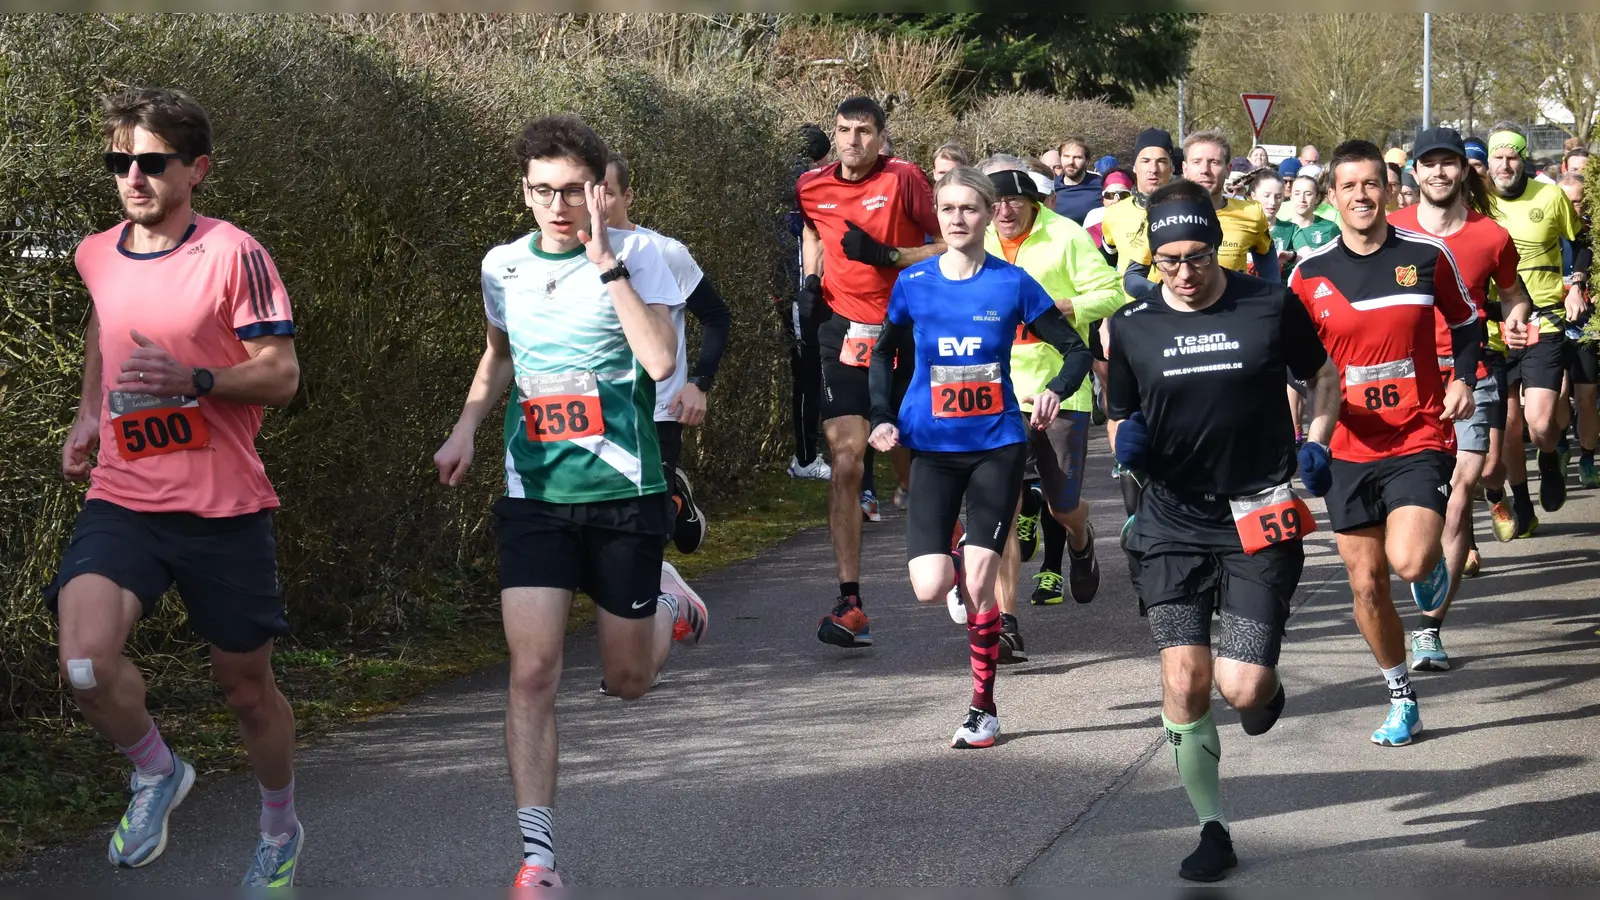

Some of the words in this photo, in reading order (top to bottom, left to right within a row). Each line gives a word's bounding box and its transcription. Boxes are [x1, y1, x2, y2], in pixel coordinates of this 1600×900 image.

[1151, 214, 1208, 232] GARMIN
[1132, 302, 1148, 313] JAKO
[938, 336, 982, 356] EVF
[1163, 347, 1178, 357] SV
[1178, 340, 1240, 355] VIRNSBERG
[1173, 332, 1227, 347] Team
[941, 386, 993, 412] 206
[1364, 384, 1401, 411] 86
[530, 400, 589, 435] 258
[122, 412, 193, 453] 500
[1259, 507, 1302, 543] 59
